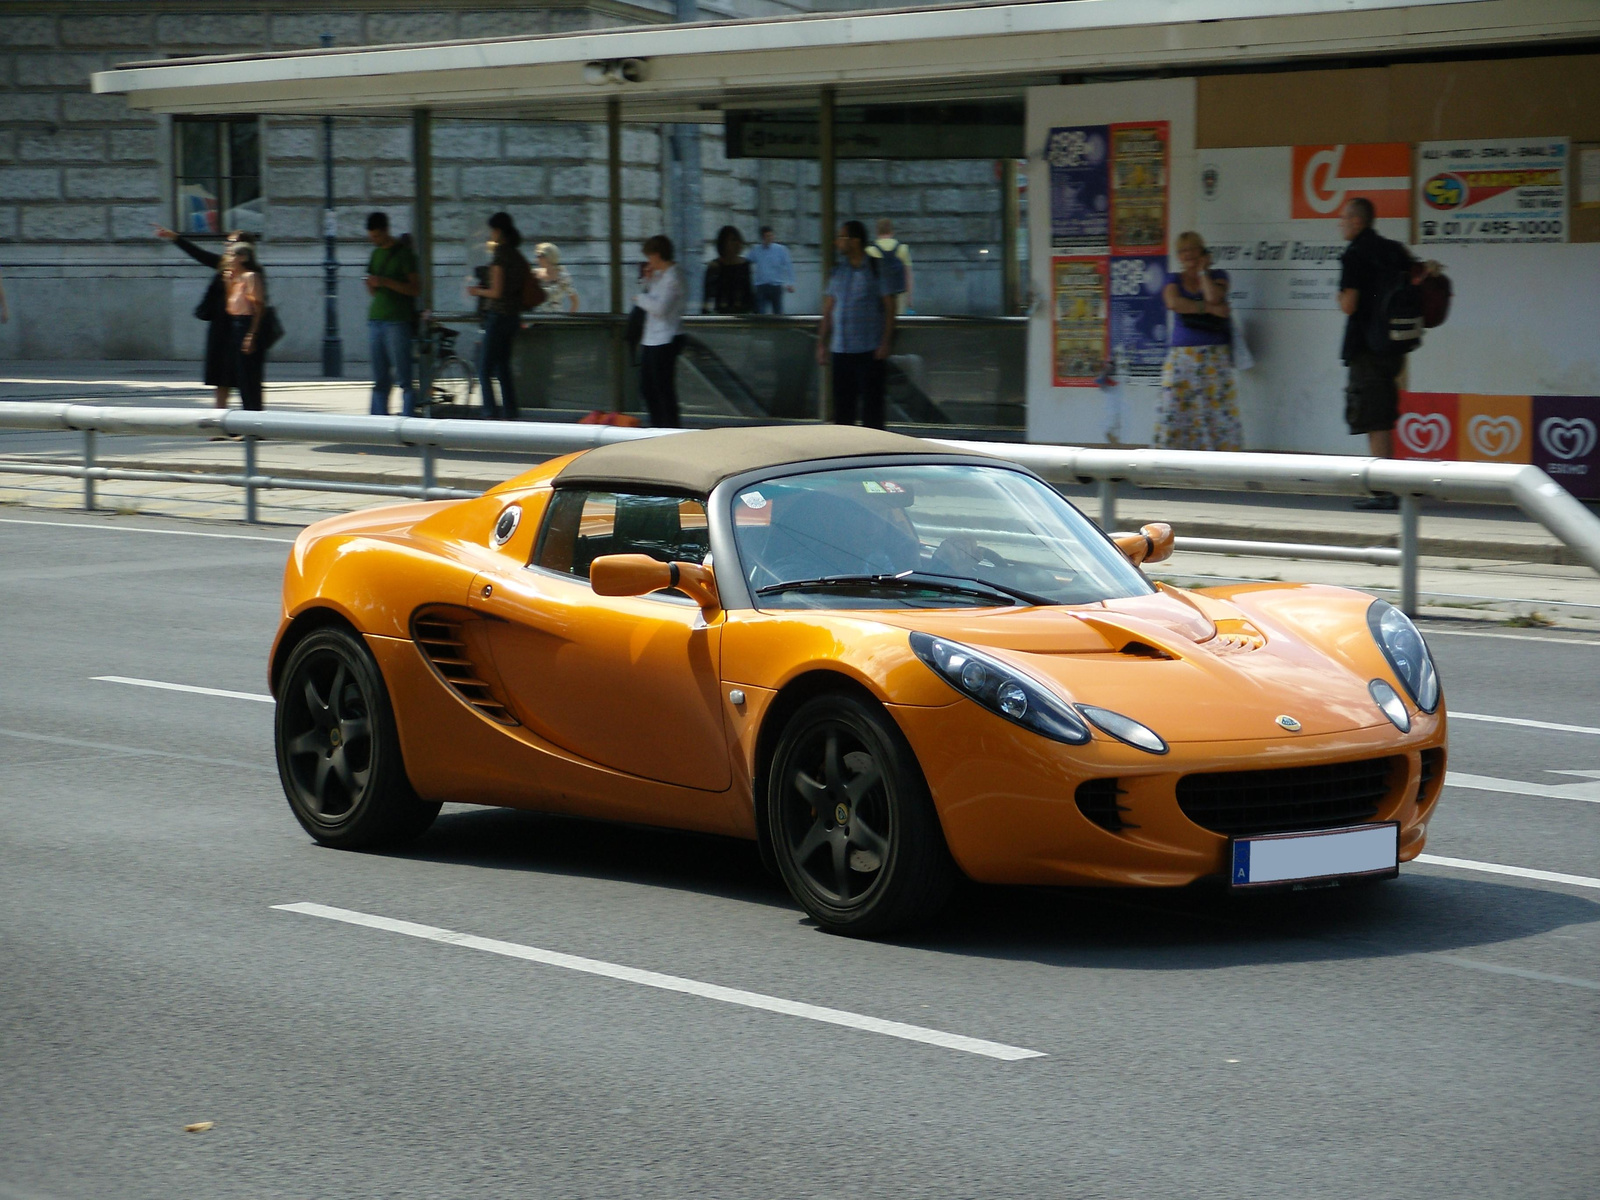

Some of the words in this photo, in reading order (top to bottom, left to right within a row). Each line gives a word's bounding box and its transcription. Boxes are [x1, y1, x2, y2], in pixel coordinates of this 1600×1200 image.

[1442, 220, 1460, 235] 01
[1479, 219, 1563, 235] 495-1000
[1237, 868, 1246, 878] A
